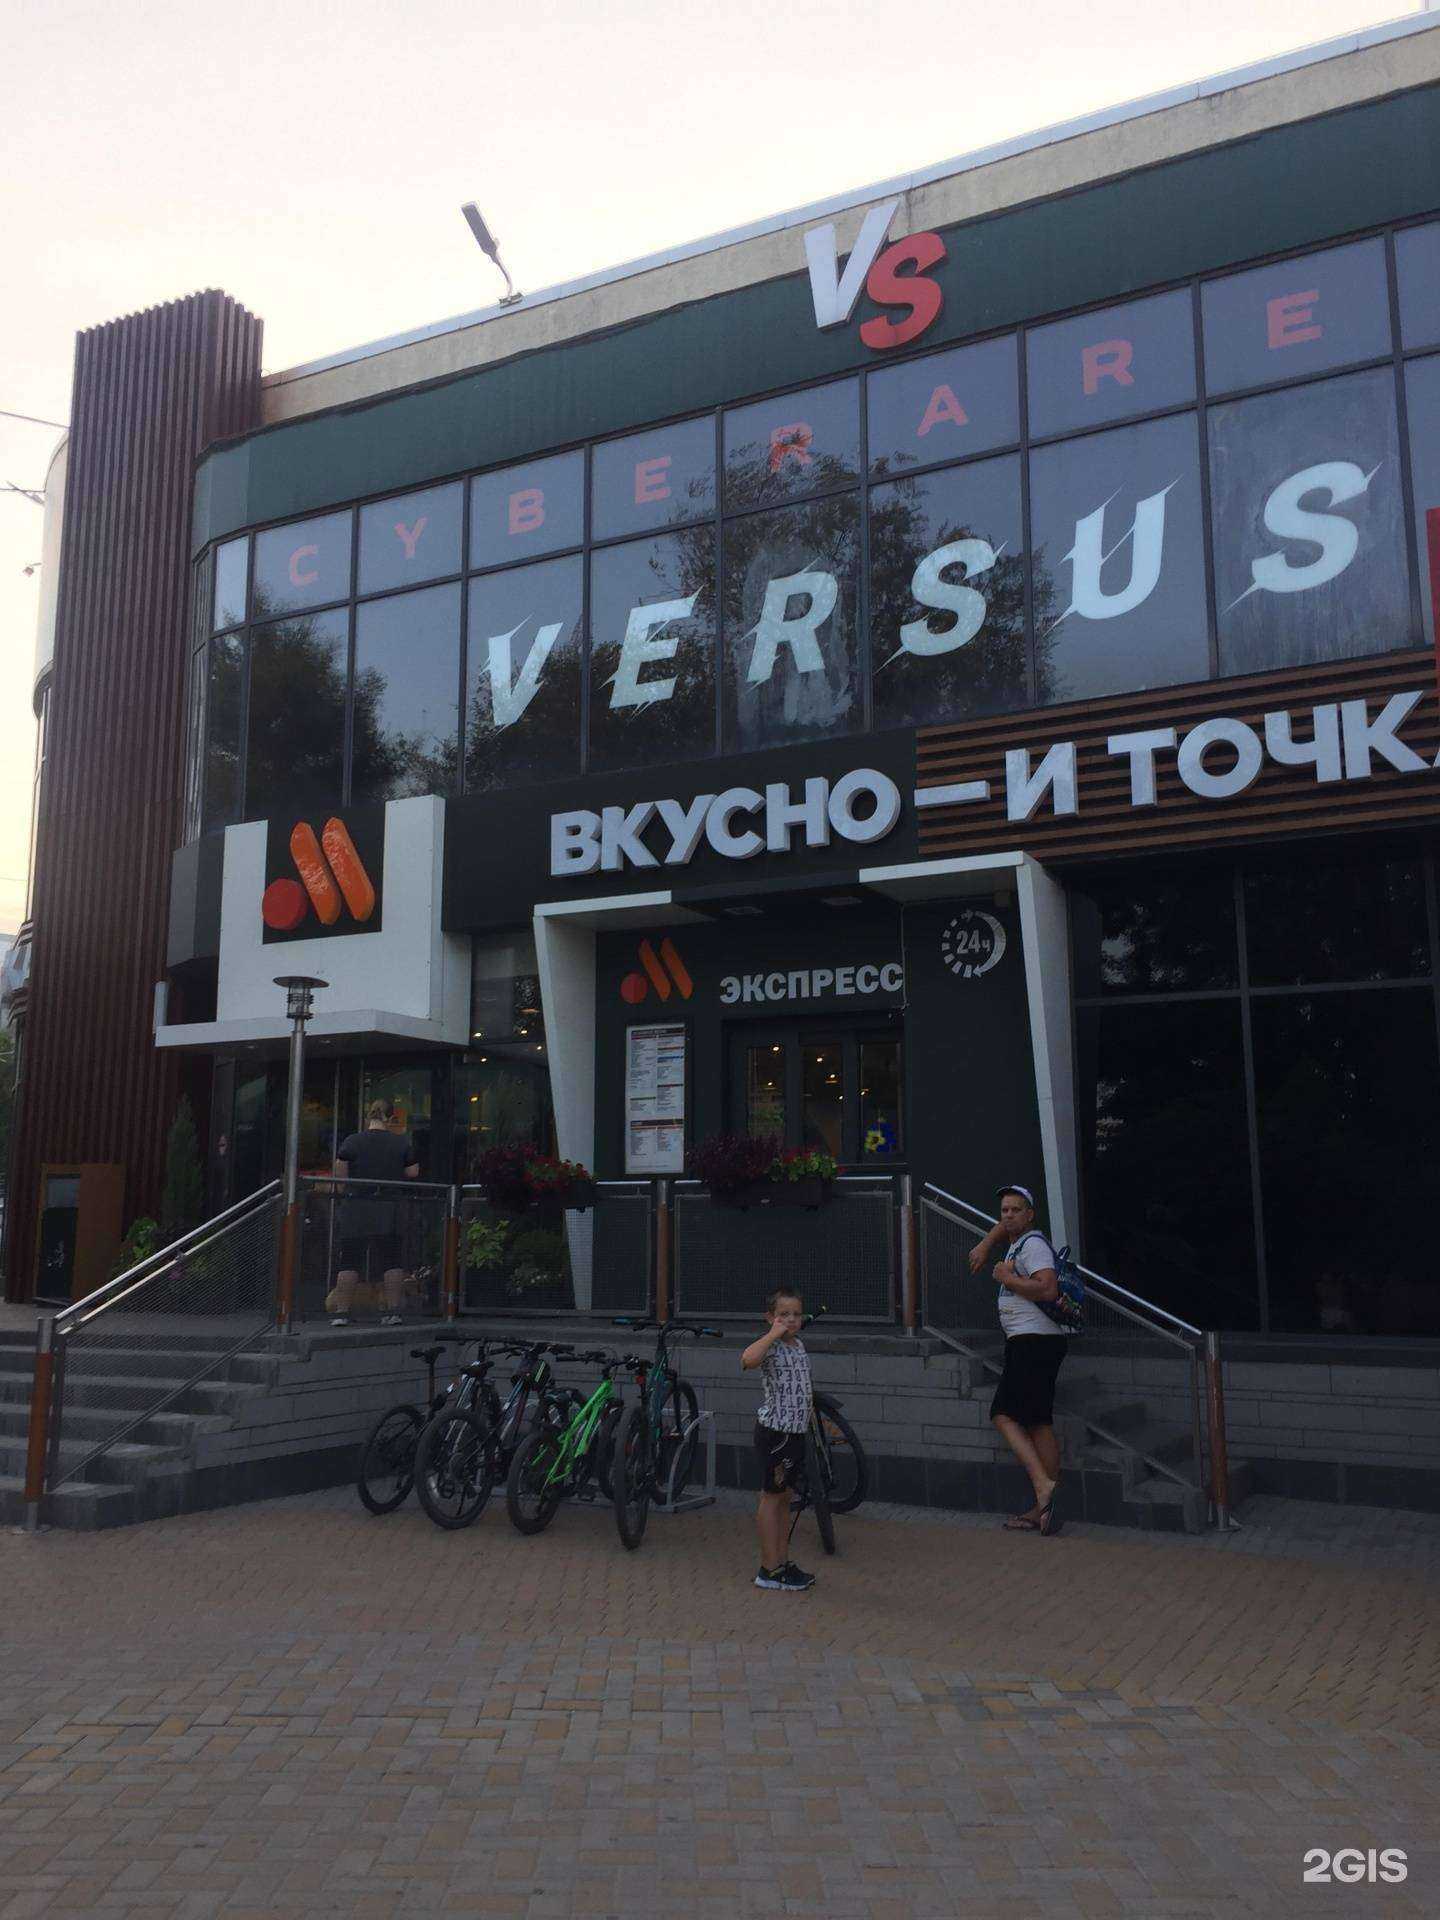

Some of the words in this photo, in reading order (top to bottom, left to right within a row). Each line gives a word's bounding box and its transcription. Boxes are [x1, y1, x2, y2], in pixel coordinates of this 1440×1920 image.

[803, 199, 949, 350] VS
[479, 461, 1383, 736] VERSUS
[550, 767, 902, 877] ВКУСНО
[1004, 741, 1080, 824] И
[1107, 690, 1440, 807] ТОЧК
[718, 962, 905, 1005] ЭКСПРЕСС
